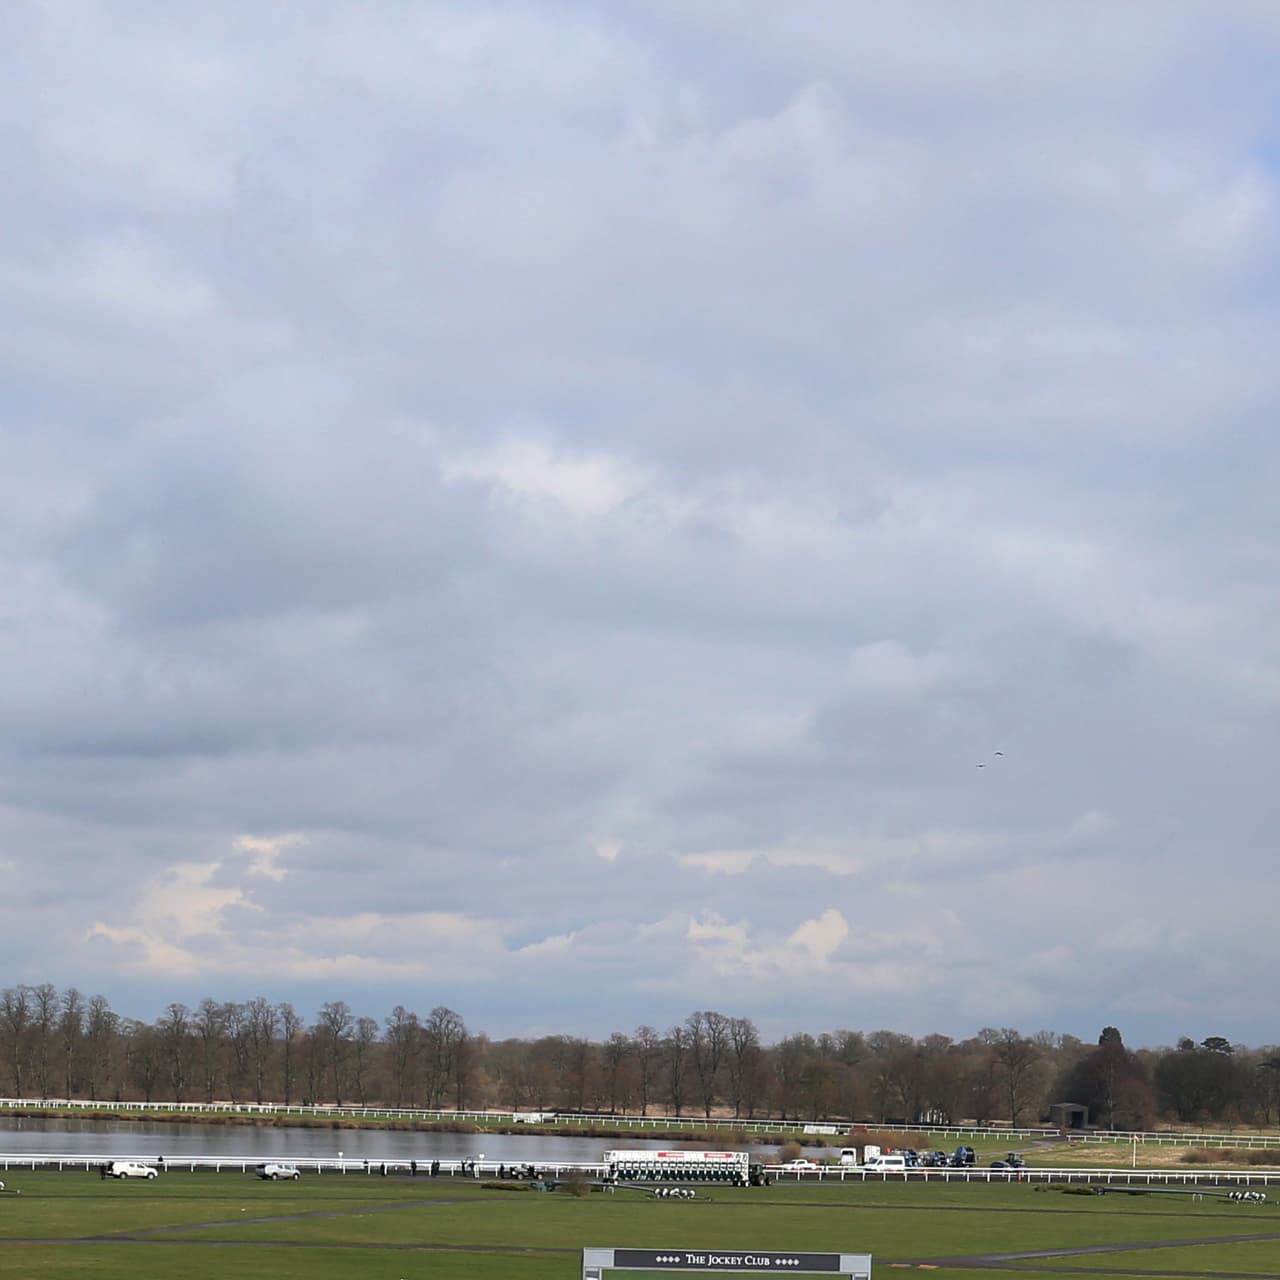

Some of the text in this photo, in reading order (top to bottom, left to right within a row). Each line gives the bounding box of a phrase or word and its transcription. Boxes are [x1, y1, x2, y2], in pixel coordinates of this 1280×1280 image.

[686, 1254, 770, 1266] THE JOCKEY CLUB
